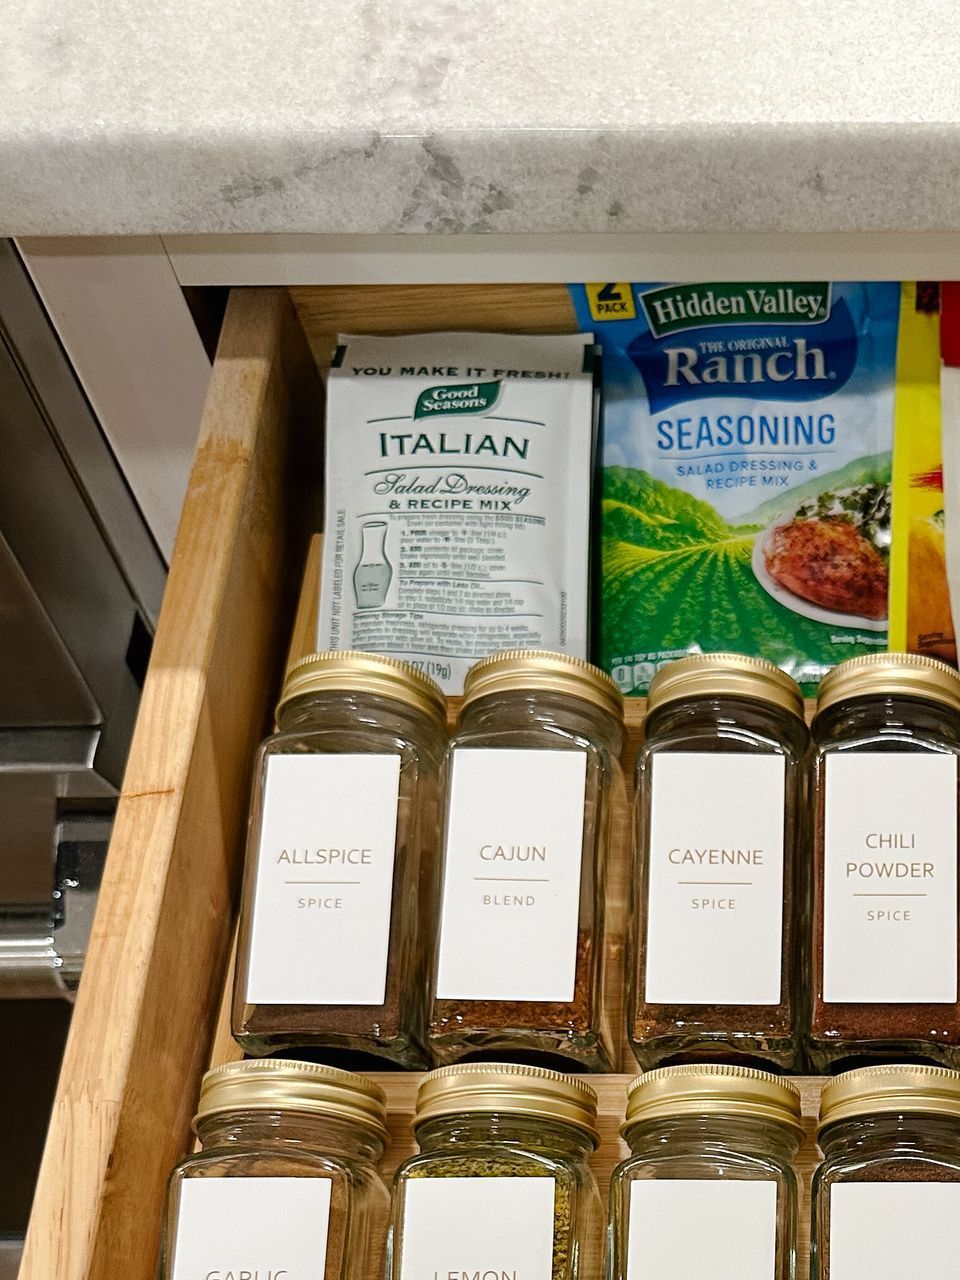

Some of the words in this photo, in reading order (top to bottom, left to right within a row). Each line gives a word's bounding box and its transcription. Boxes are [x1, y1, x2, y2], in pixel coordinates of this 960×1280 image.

[597, 302, 628, 314] PACK
[652, 290, 746, 325] Hidden
[746, 288, 823, 319] Valley
[700, 341, 726, 354] THE
[728, 336, 791, 351] ORIGINAL
[663, 339, 828, 387] Ranch
[352, 367, 392, 376] YOU
[400, 366, 457, 377] MAKE
[466, 367, 487, 378] IT
[493, 369, 571, 380] FRESH!
[432, 386, 480, 401] Good
[422, 397, 487, 412] Seasons
[657, 414, 837, 450] SEASONING
[380, 433, 530, 460] ITALIAN
[676, 462, 725, 477] SALAD
[730, 459, 804, 472] DRESSING
[808, 459, 818, 471] &
[374, 473, 443, 496] Salad
[440, 473, 531, 505] Dressing
[706, 475, 758, 490] RECIPE
[762, 475, 789, 487] MIX
[389, 499, 401, 509] &
[408, 499, 473, 510] RECIPE
[480, 500, 512, 511] MIX
[335, 509, 346, 528] SALE
[334, 528, 346, 552] RETAIL
[334, 553, 344, 568] FOR
[332, 569, 343, 600] LABELED
[332, 601, 342, 616] NOT
[330, 618, 341, 635] UNIT
[865, 833, 916, 850] CHILI
[276, 848, 373, 865] ALLSPICE
[479, 844, 547, 862] CAJUN
[667, 847, 764, 866] CAYENNE
[845, 862, 935, 879] POWDER
[295, 897, 343, 910] SPICE
[482, 894, 536, 907] BLEND
[691, 898, 737, 910] SPICE
[866, 910, 912, 922] SPICE
